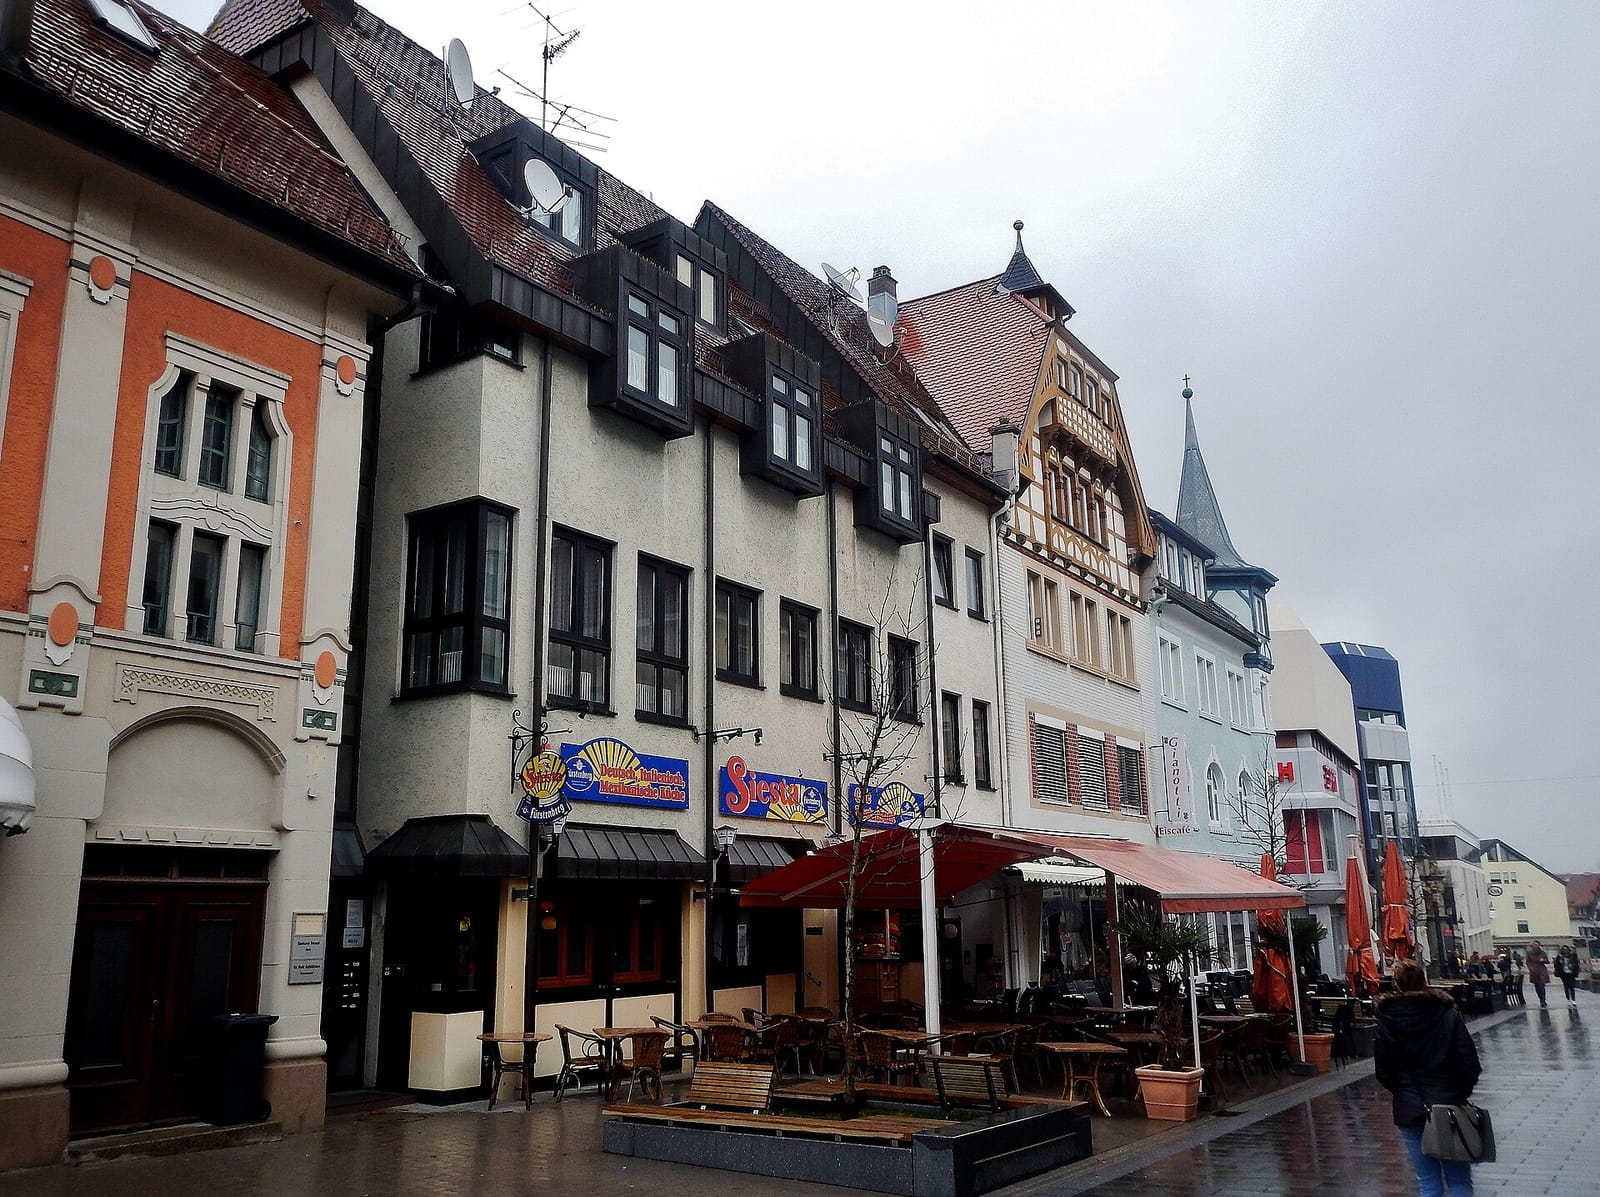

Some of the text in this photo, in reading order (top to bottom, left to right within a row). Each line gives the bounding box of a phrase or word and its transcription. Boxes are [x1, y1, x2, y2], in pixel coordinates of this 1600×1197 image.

[726, 755, 801, 814] Siesta
[1168, 736, 1181, 818] Gianotti
[660, 786, 685, 802] Küche
[529, 803, 565, 819] Fürstenberg
[1159, 825, 1191, 835] Eiscafé
